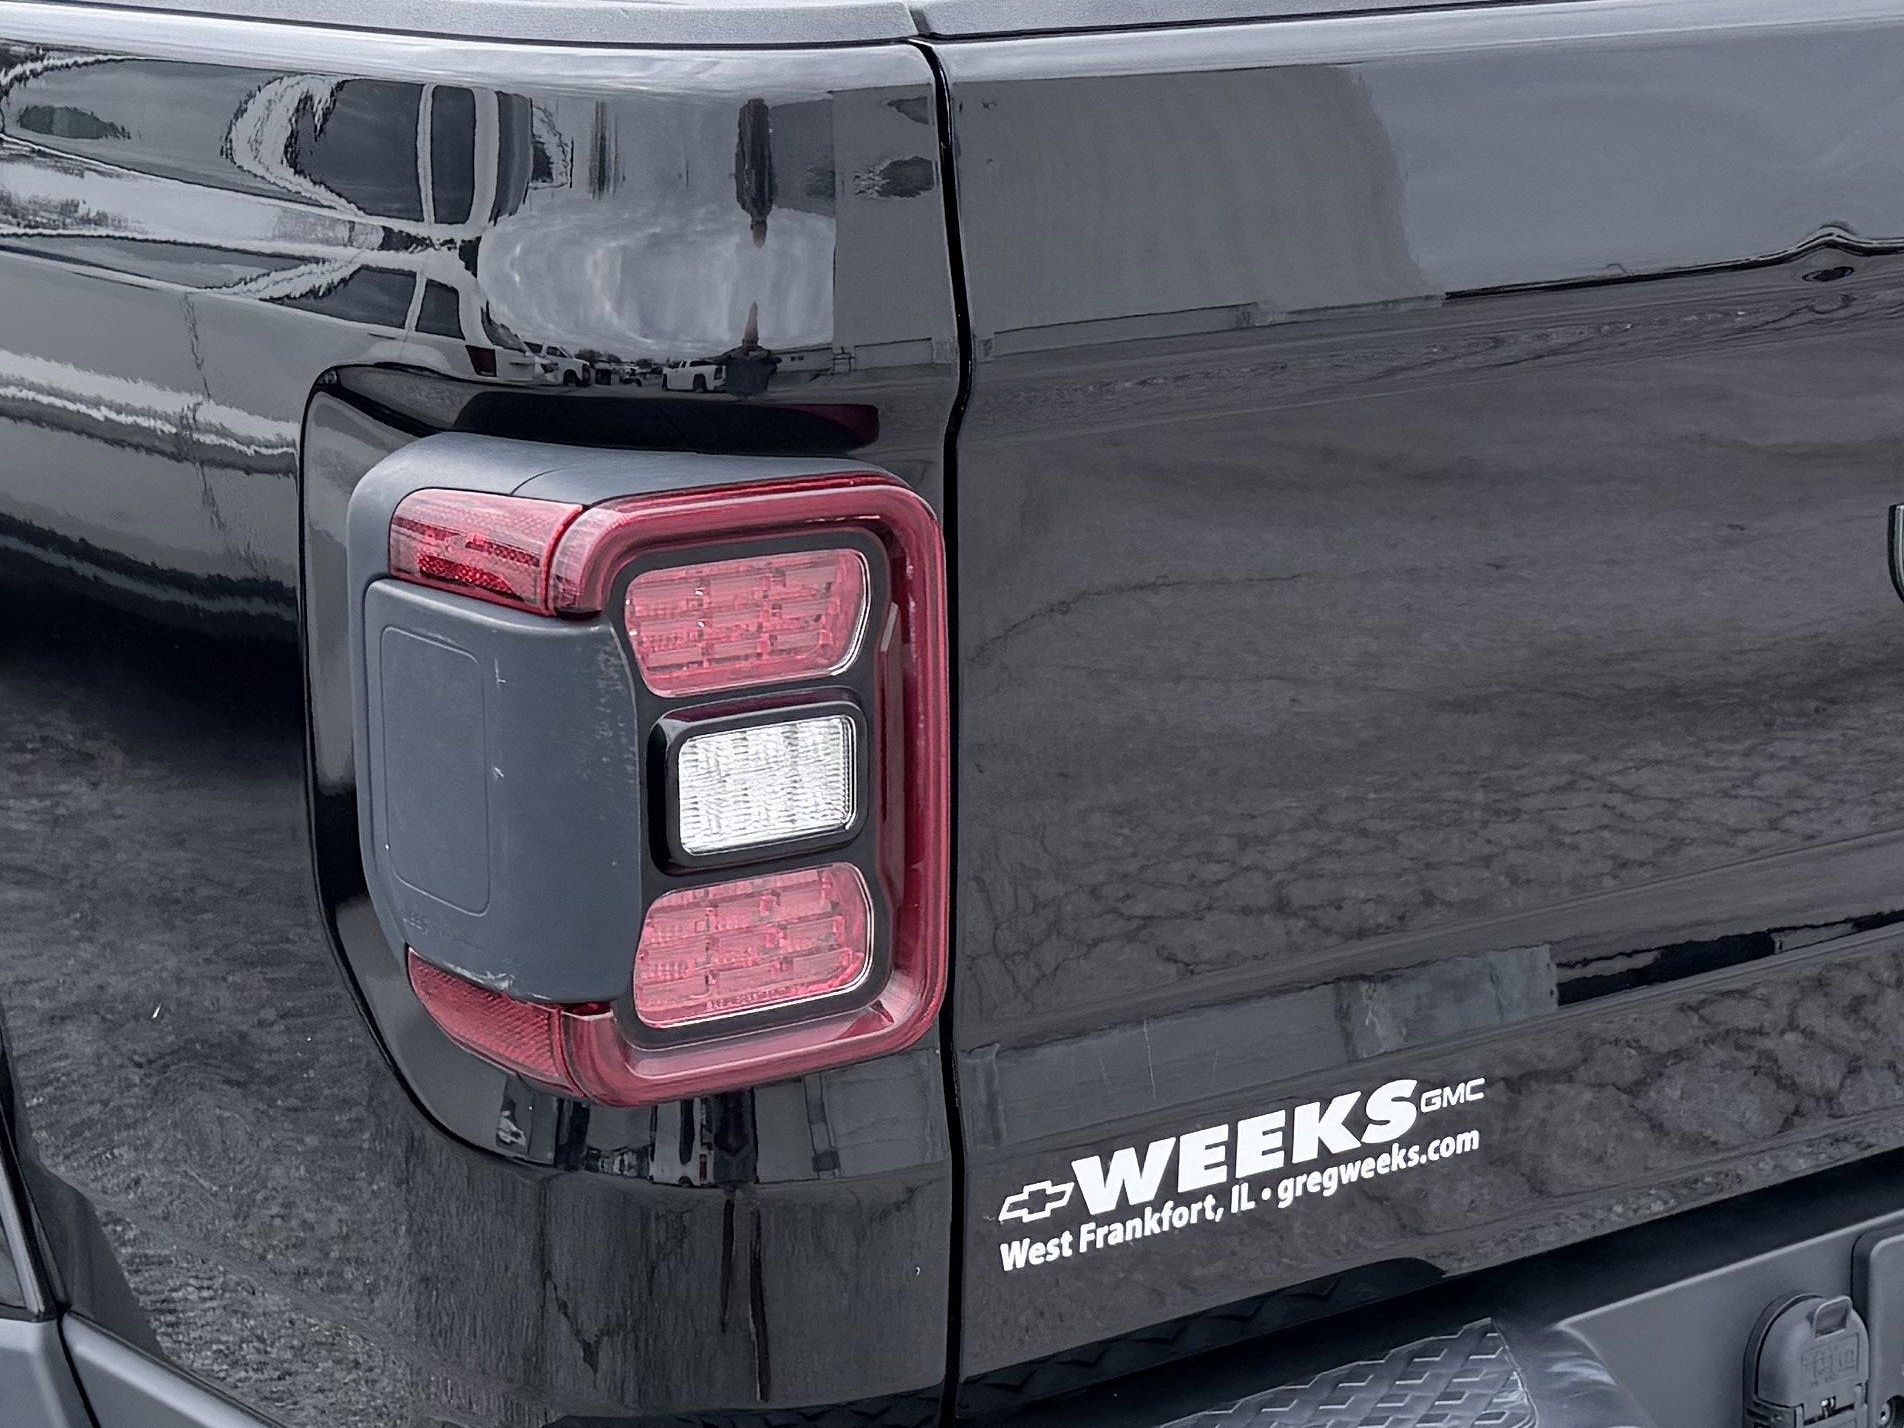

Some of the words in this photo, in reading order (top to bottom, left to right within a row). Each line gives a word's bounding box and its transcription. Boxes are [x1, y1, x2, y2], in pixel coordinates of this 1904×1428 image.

[999, 1230, 1074, 1272] West
[1079, 1193, 1225, 1254] Frankfort,
[1230, 1182, 1256, 1214] IL
[1277, 1129, 1480, 1209] gregweeks.com
[1071, 1079, 1418, 1215] WEEKS
[1420, 1077, 1486, 1114] GMC
